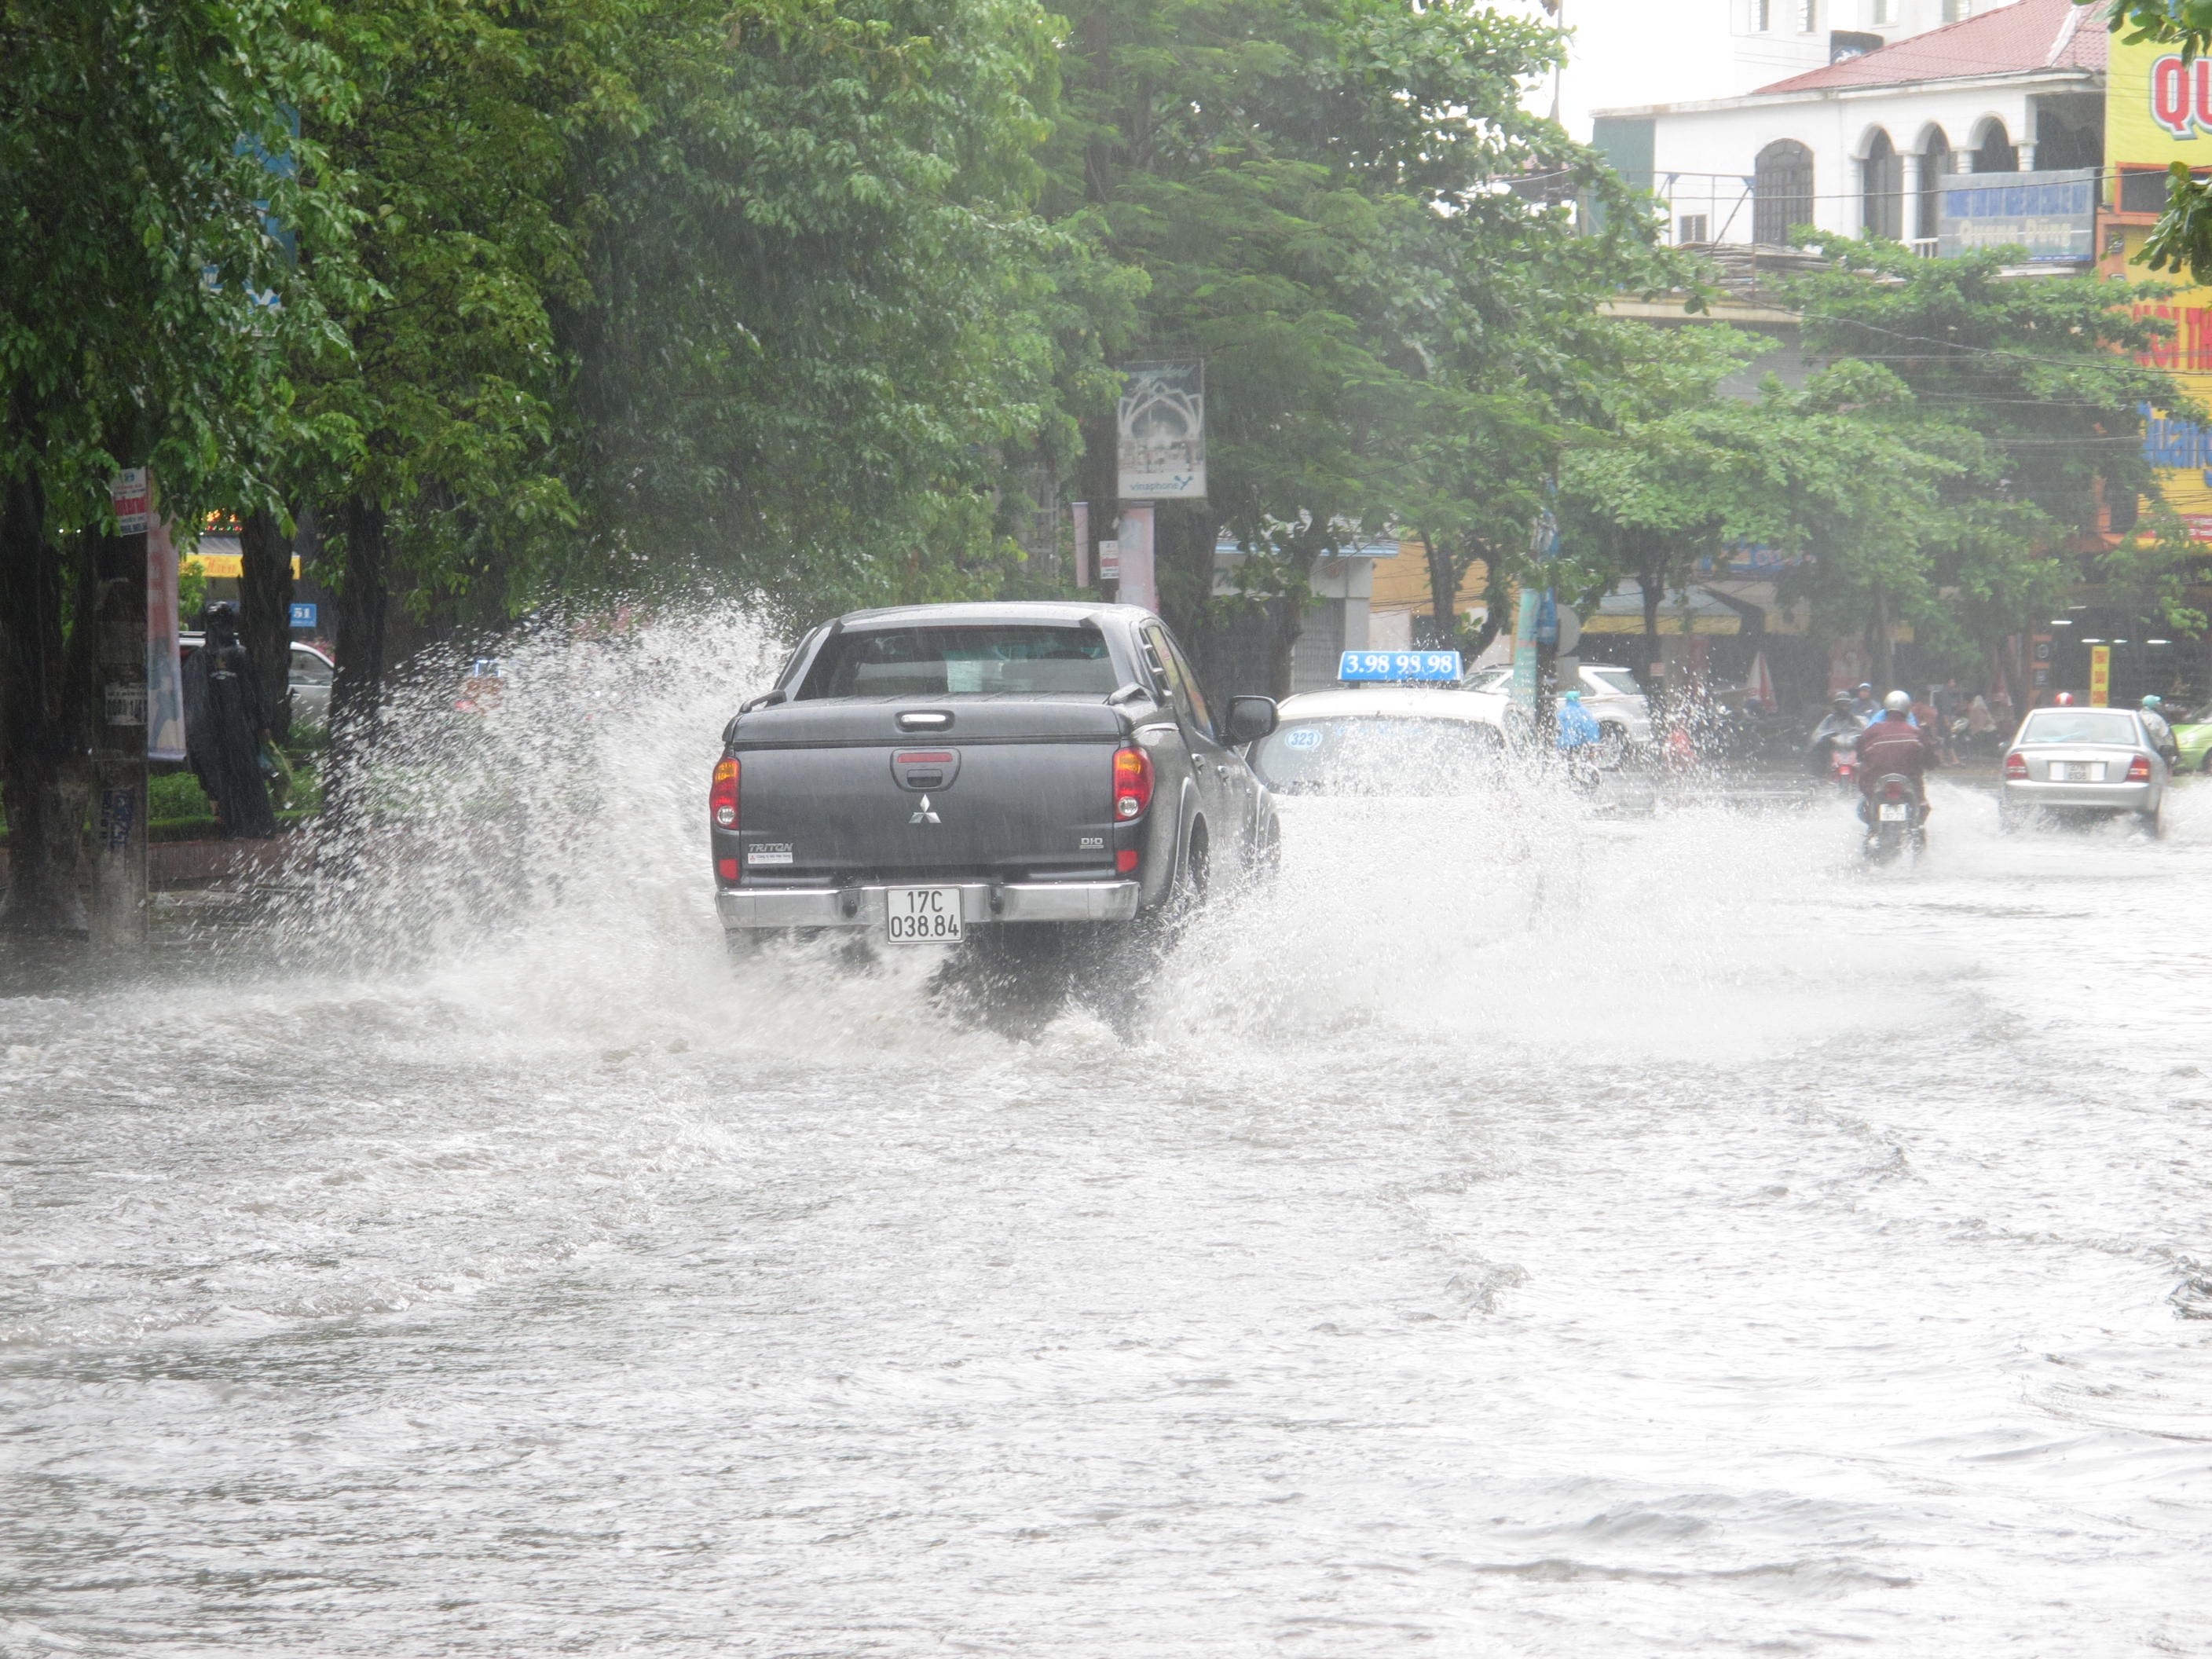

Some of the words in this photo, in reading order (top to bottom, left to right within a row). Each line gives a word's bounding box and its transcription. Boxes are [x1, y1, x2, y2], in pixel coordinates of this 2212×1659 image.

[294, 607, 311, 619] 51
[1346, 655, 1390, 673] 3.98
[1396, 655, 1421, 673] 98
[1427, 655, 1453, 673] 98
[1290, 733, 1314, 745] 323
[749, 843, 793, 852] TRITON
[907, 890, 943, 914] 17C
[891, 914, 959, 938] 038.84
